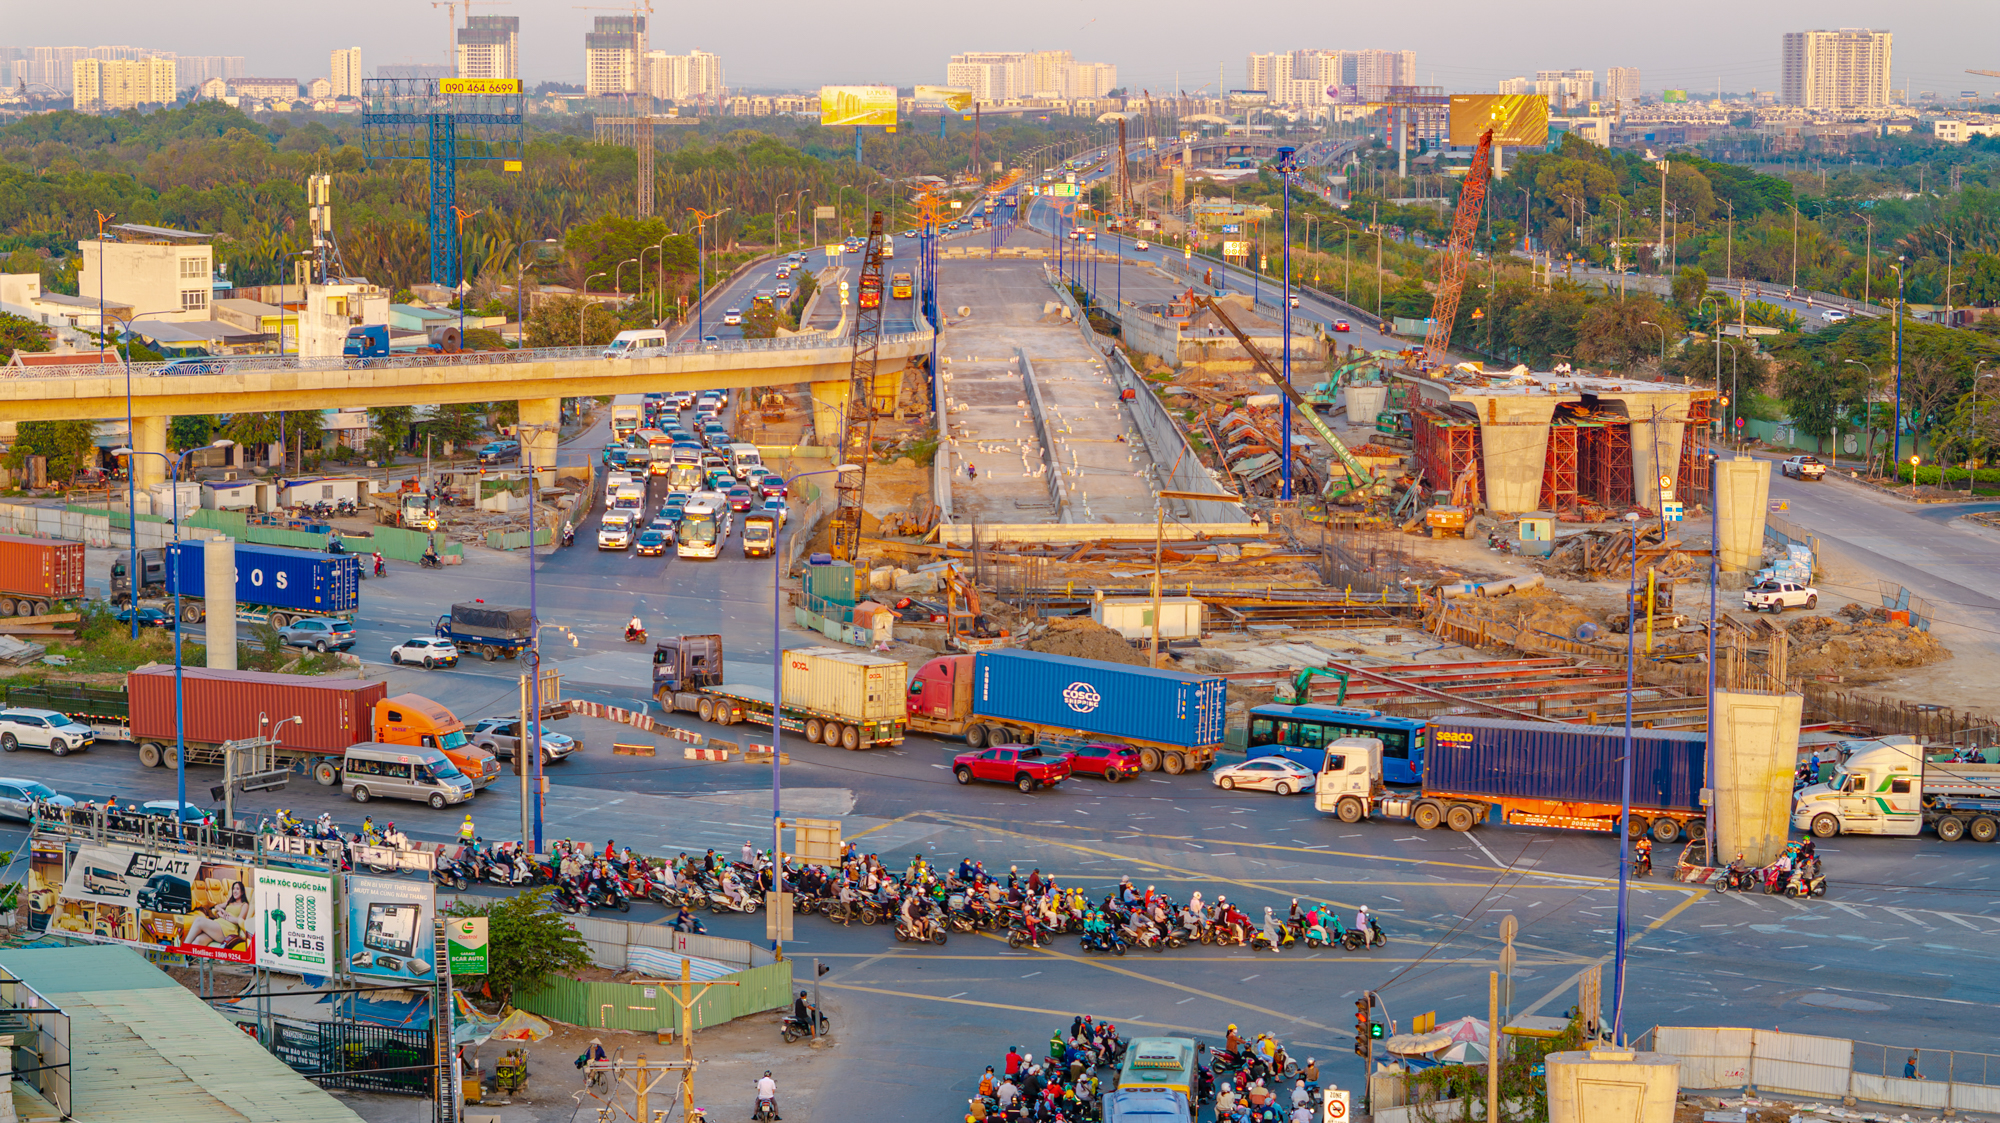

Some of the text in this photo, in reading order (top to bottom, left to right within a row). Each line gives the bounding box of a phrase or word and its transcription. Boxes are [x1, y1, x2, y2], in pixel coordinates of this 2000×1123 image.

[445, 84, 513, 92] 090 464 6699
[1062, 689, 1101, 702] COSCO
[1064, 697, 1099, 708] SHIPPING
[1436, 732, 1474, 742] seaco
[136, 854, 190, 874] SOLATI
[259, 876, 276, 885] GIẢM
[277, 879, 291, 887] XÓC
[292, 881, 311, 890] QUỐC
[288, 937, 324, 951] H.B.S
[679, 936, 686, 950] H
[192, 948, 213, 957] Hotline:
[290, 1047, 300, 1056] BẢO
[285, 1054, 297, 1063] HIỆU
[298, 1056, 308, 1064] ỨNG
